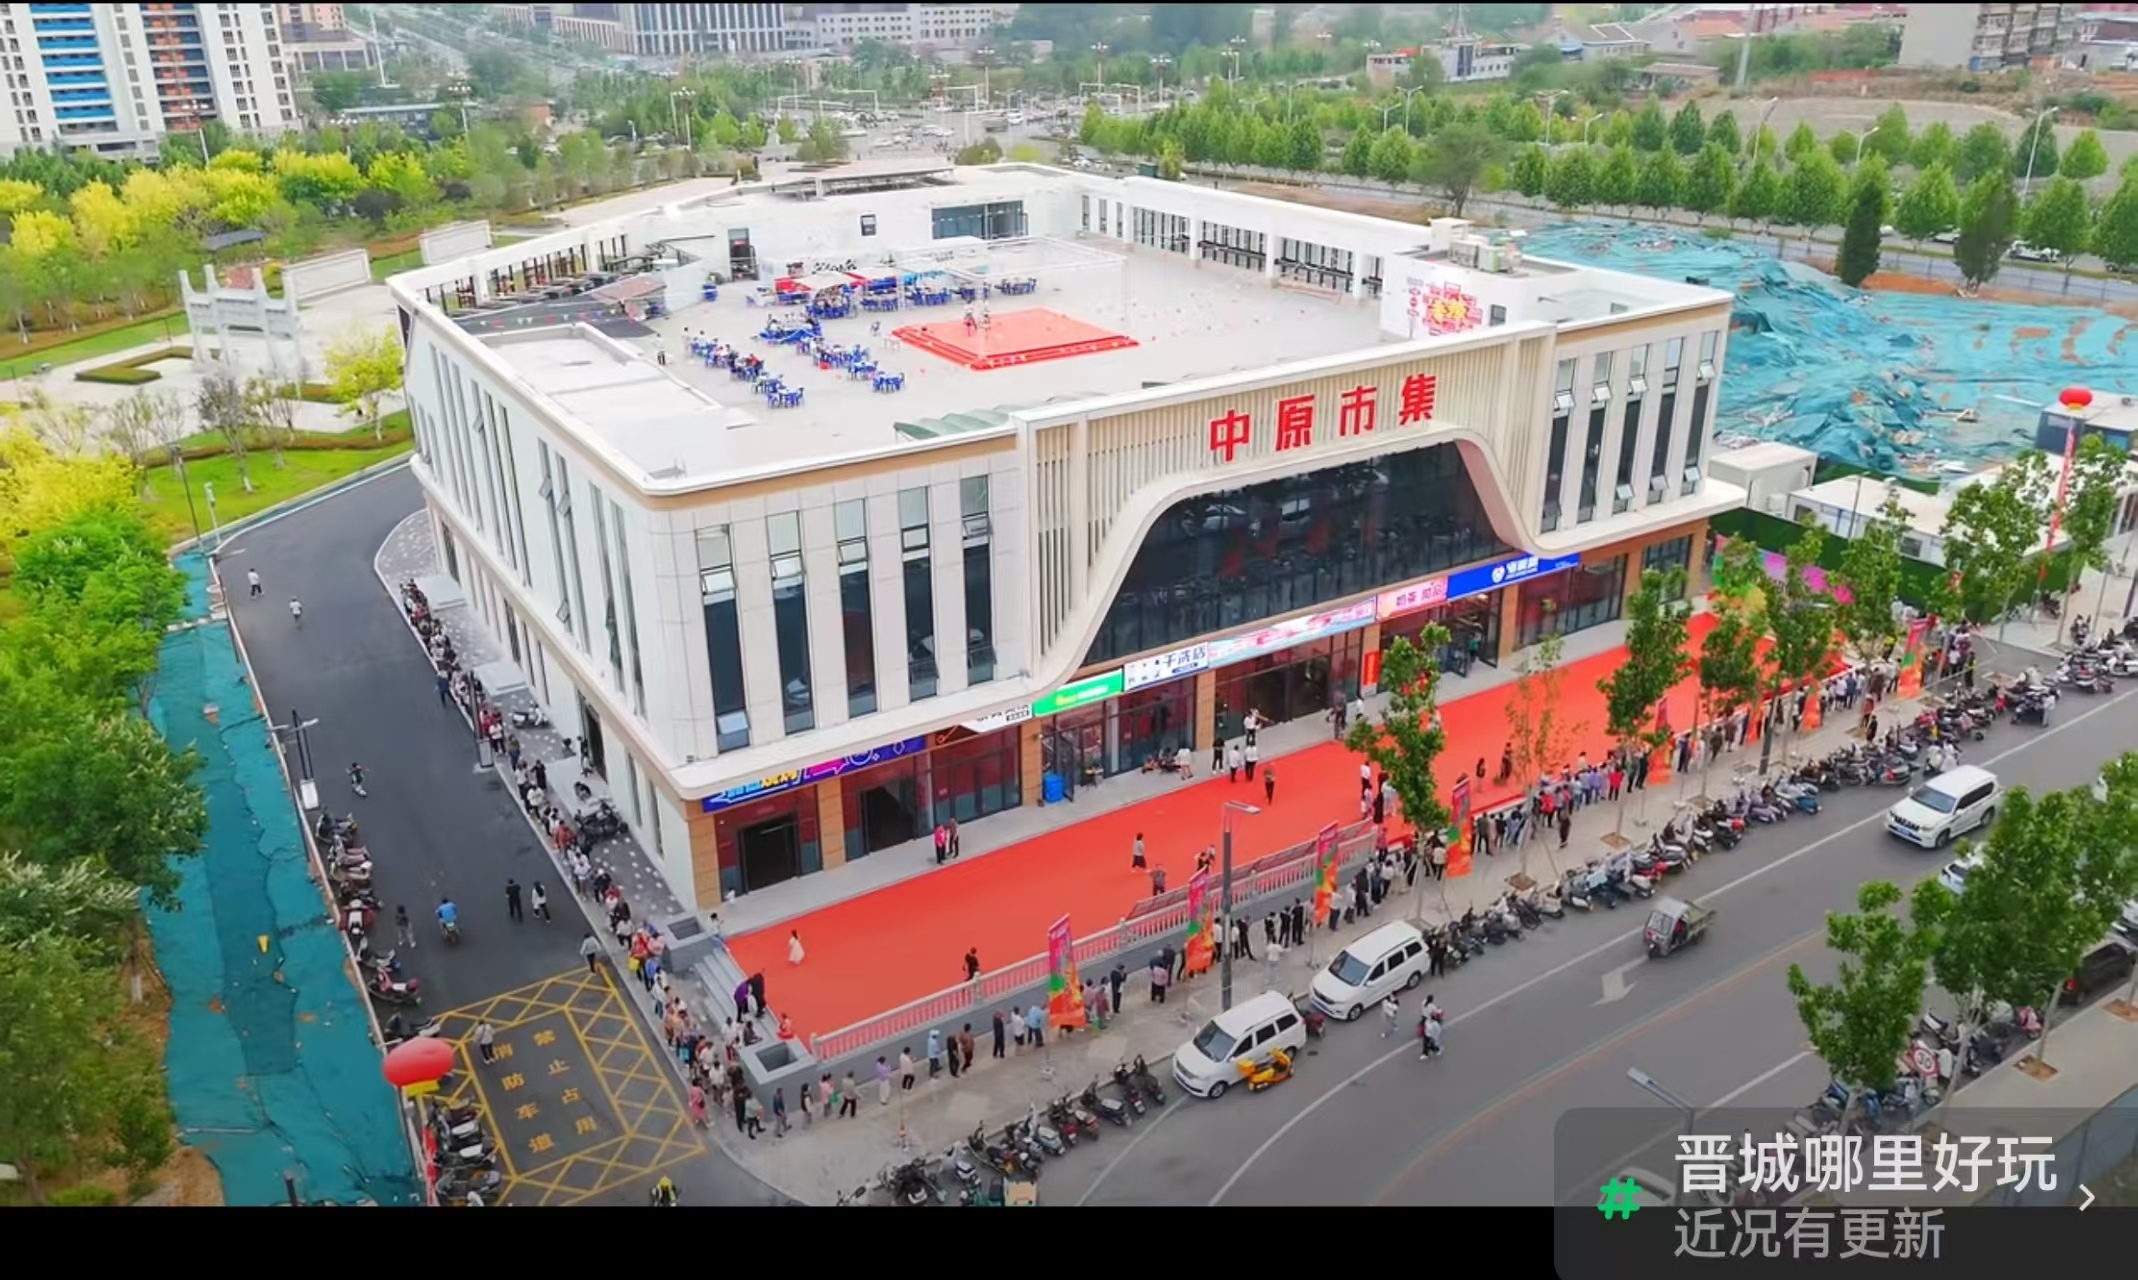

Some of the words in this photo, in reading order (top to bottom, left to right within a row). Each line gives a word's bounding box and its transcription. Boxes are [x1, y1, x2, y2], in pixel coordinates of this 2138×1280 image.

[1209, 373, 1436, 462] 中原市集
[492, 1043, 555, 1153] 消防车道
[533, 1029, 597, 1135] 禁止占用
